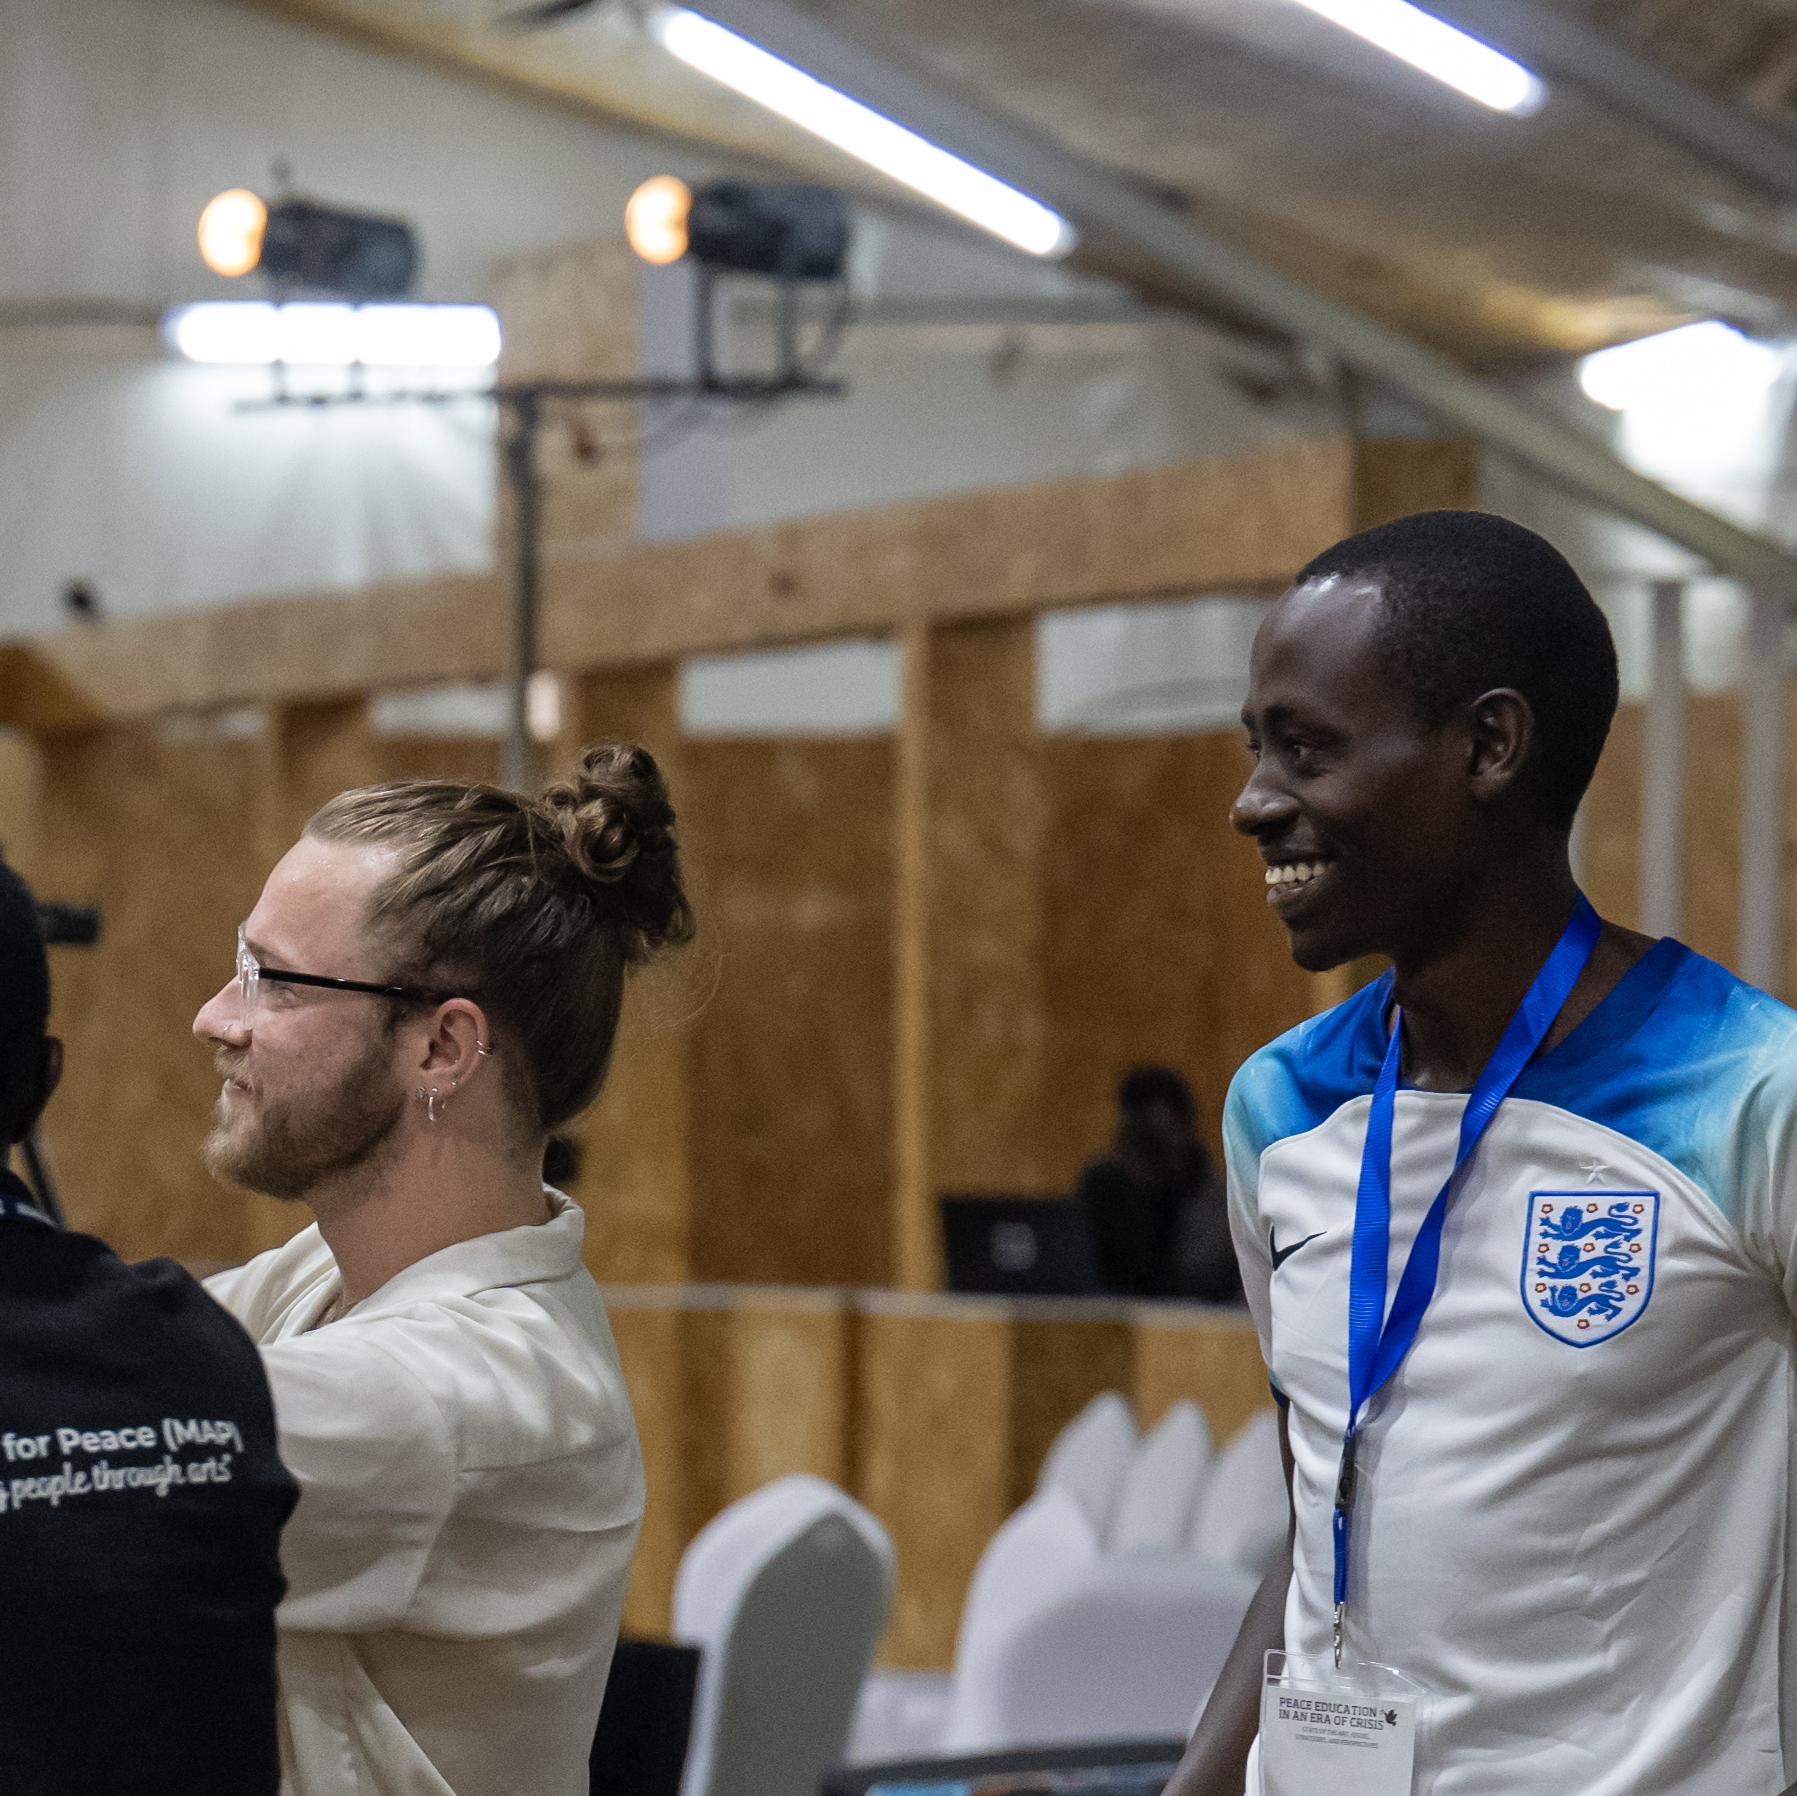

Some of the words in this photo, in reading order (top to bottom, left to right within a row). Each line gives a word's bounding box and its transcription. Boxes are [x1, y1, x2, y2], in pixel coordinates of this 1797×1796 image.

[1, 1430, 51, 1462] for
[56, 1425, 157, 1456] Peace
[162, 1416, 245, 1454] (MAP)
[10, 1461, 93, 1508] people
[91, 1454, 187, 1498] through
[1278, 1696, 1313, 1711] PEACE
[1313, 1700, 1378, 1718] EDUCATION
[1278, 1708, 1290, 1720] IN
[1291, 1710, 1308, 1722] AN
[1309, 1712, 1332, 1725] ERA
[1333, 1715, 1348, 1726] OF
[1349, 1717, 1385, 1731] CRISIS
